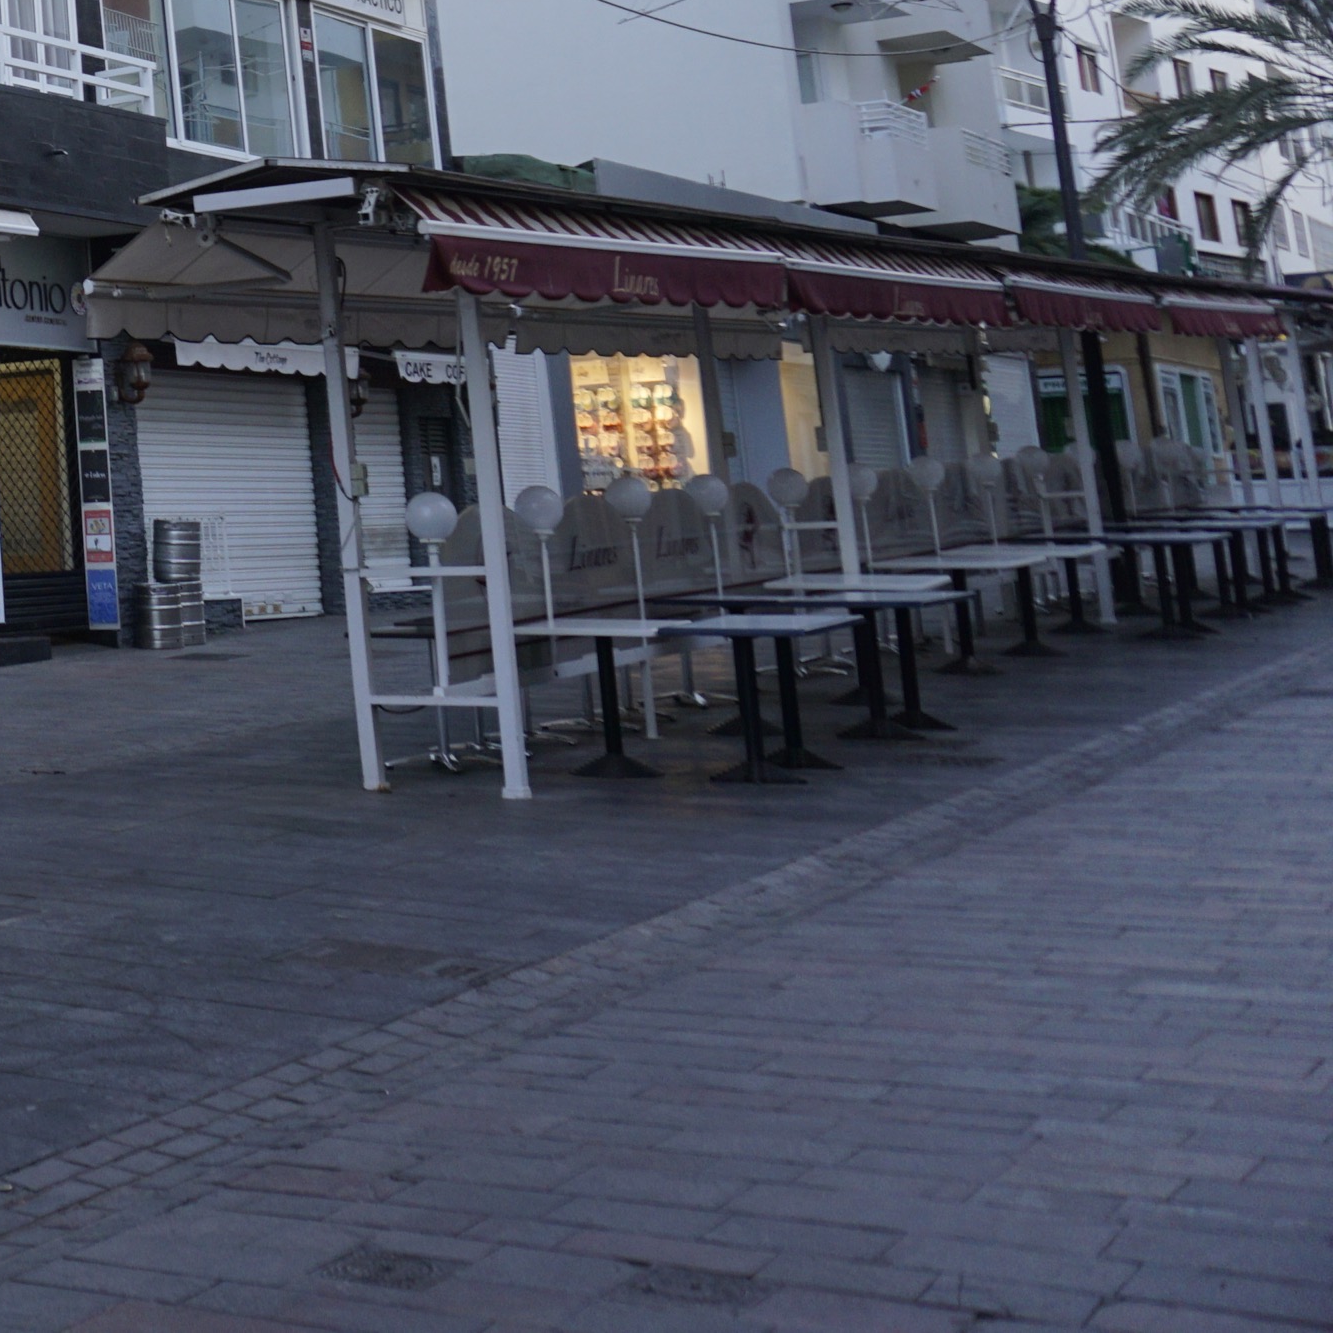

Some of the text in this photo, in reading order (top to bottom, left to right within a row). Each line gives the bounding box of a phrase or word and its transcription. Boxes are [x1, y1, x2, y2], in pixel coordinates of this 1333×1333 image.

[449, 253, 519, 282] desde 1957
[612, 255, 660, 297] Linares
[405, 361, 434, 379] CAKE
